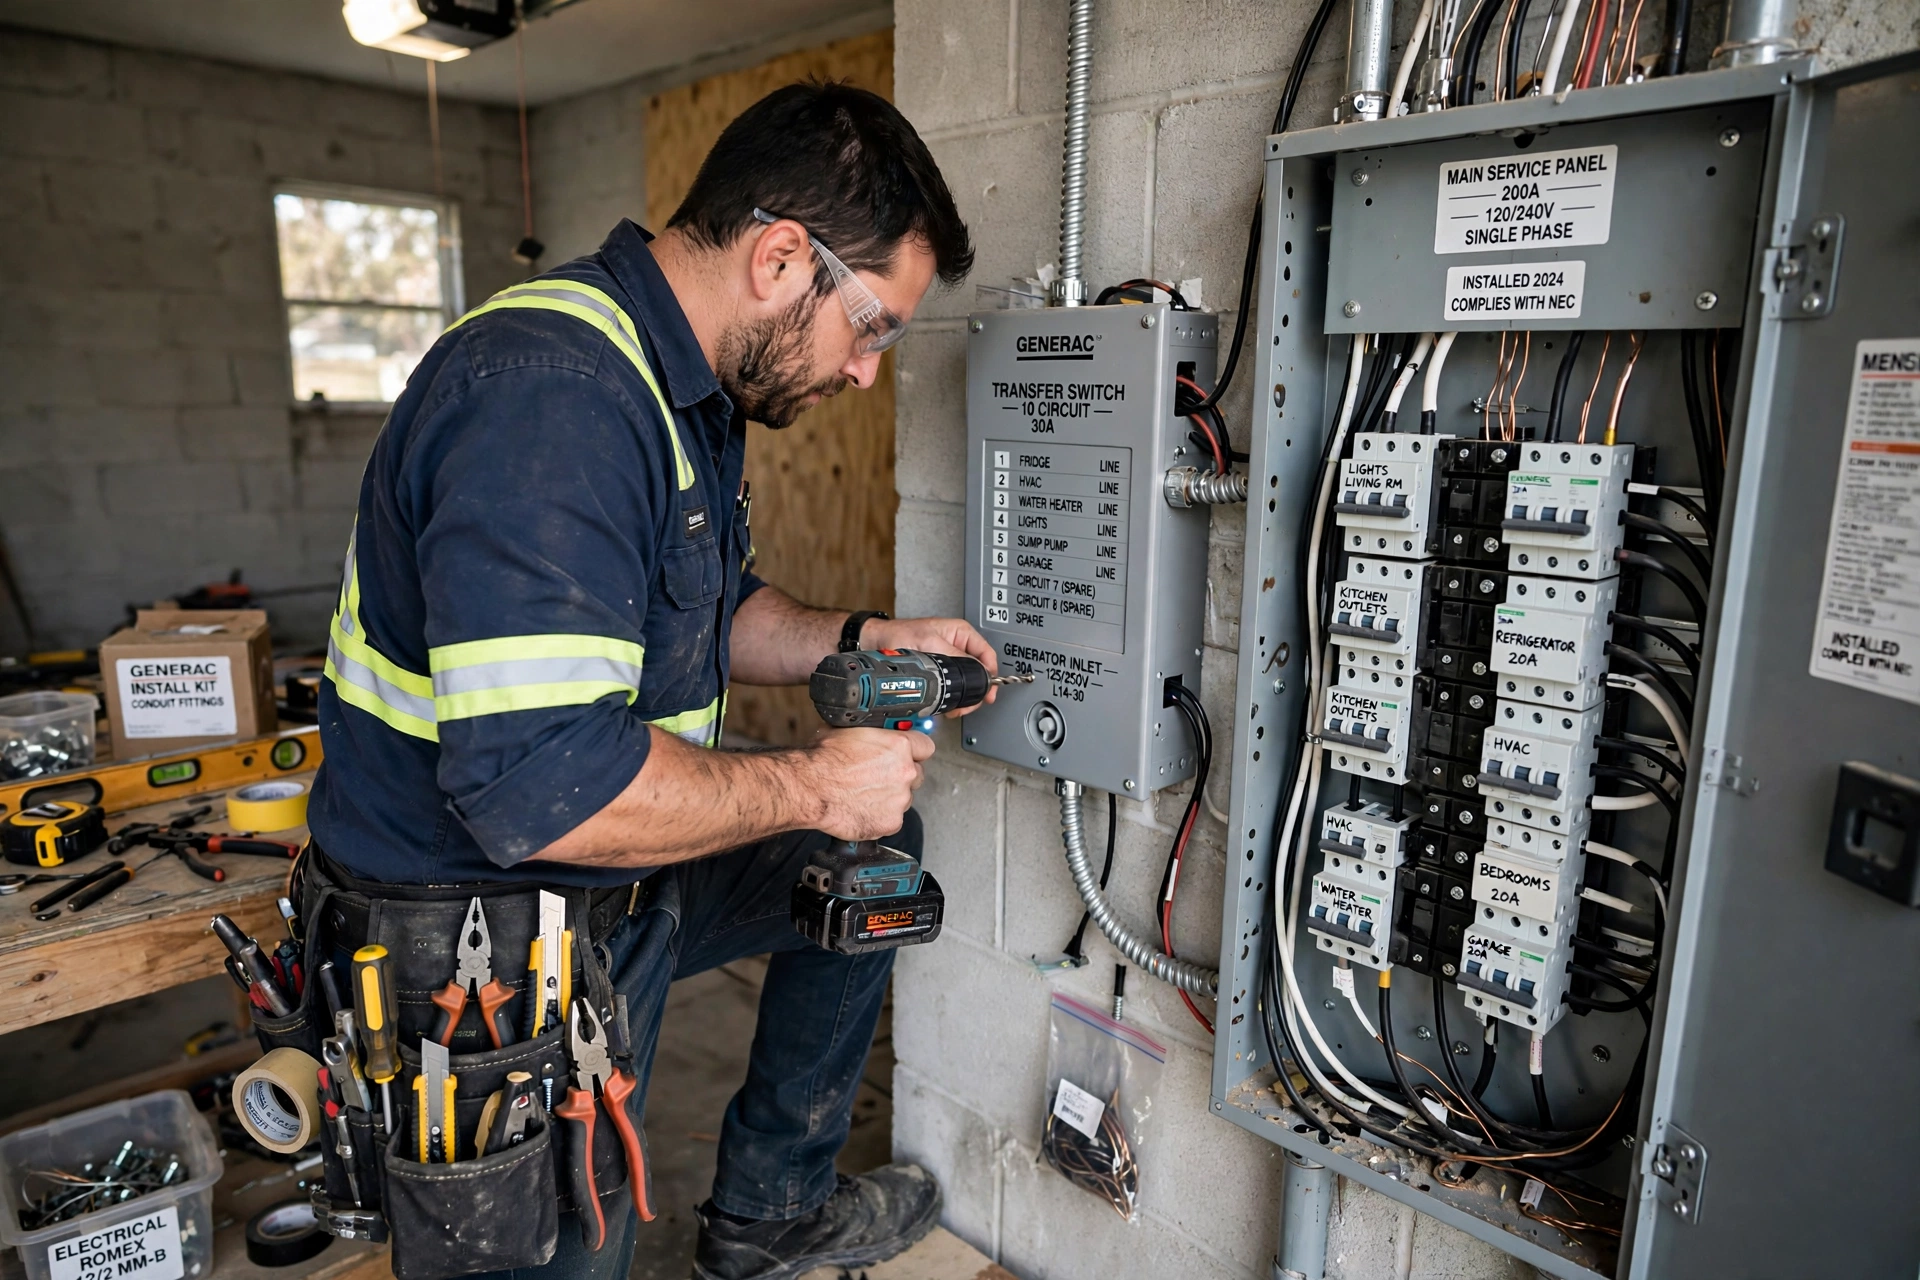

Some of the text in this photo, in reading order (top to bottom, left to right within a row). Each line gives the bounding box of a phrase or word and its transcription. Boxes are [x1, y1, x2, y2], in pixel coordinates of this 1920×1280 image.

[1447, 154, 1607, 185] MAIN SERVICE PANEL
[1501, 182, 1540, 201] 200A
[1485, 202, 1555, 223] 120/240V
[1465, 222, 1573, 245] SINGLE PHASE
[1462, 272, 1564, 290] INSTALLED 2024
[1451, 294, 1575, 312] COMPLIES WITH NEC
[1016, 335, 1095, 353] GENERAC
[992, 382, 1125, 401] TRANSFER SWITCH
[1021, 402, 1090, 418] 10 CIRCUIT
[1031, 419, 1055, 434] 30A
[1000, 455, 1120, 473] 1 FRIDGE LINE
[1348, 463, 1389, 476] LIGHTS
[999, 474, 1119, 495] 2 HVAC LINE
[1345, 477, 1402, 489] LIVING RM
[999, 494, 1118, 516] 3 WATER HEATER LINE
[998, 513, 1118, 538] 4 LIGHTS LINE
[998, 533, 1117, 559] 5 SUMP PUMP LINE
[997, 552, 1116, 580] 6 GARAGE LINE
[997, 572, 1096, 600] 7 CIRCUIT 7 (SPARE)
[1340, 586, 1388, 603] KITCHEN
[997, 590, 1095, 619] 8 CIRCUIT 8 (SPARE)
[1338, 599, 1388, 615] OUTLETS
[988, 608, 1044, 627] 9-10 SPARE
[1496, 629, 1576, 654] REFRIGERATOR
[1004, 643, 1103, 676] GENERATOR INLET
[1508, 652, 1538, 667] 20A
[130, 663, 217, 677] GENERAC
[1015, 660, 1089, 689] 30A 125/250V
[131, 680, 217, 695] INSTALL KIT
[1053, 684, 1084, 702] L14-30
[131, 697, 224, 709] CONDUIT FITTINGS
[1332, 692, 1378, 710] KITCHEN
[1330, 705, 1378, 723] OUTLETS
[1494, 737, 1531, 755] HVAC
[1326, 815, 1353, 832] HVAC
[1480, 862, 1551, 892] BEDROOMS
[1320, 881, 1356, 902] WATER
[1490, 888, 1520, 906] 20A
[1333, 898, 1372, 920] HEATER
[1467, 935, 1512, 957] GARAGE
[1467, 946, 1488, 960] 20A
[55, 1216, 167, 1262] ELECTRICAL
[80, 1237, 146, 1272] ROMEX
[118, 1248, 166, 1276] MM-B
